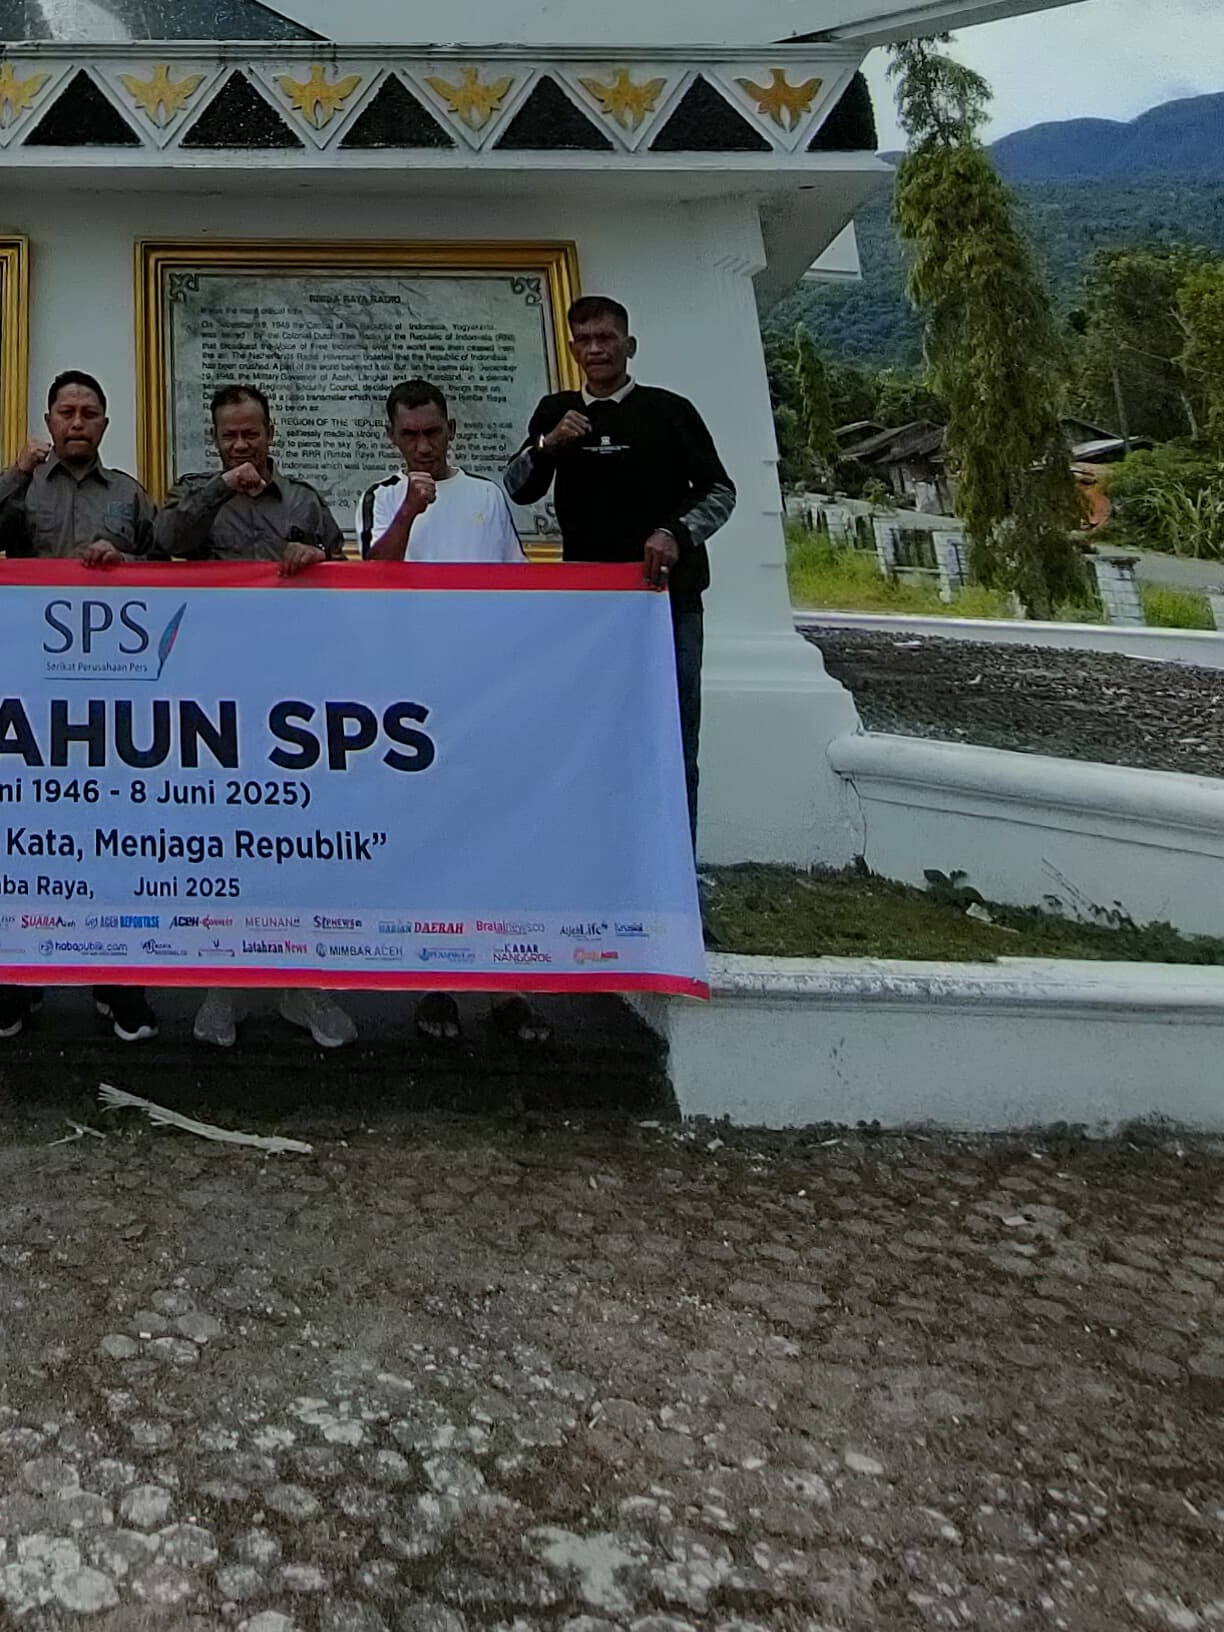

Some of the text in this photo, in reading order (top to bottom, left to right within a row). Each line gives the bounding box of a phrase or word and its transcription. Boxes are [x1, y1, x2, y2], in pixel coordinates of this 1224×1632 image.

[42, 599, 150, 655] SPS
[46, 662, 148, 673] Serikat Perusahaan Pers
[267, 699, 437, 773] SPS
[34, 779, 100, 805] 1946
[130, 780, 147, 805] 8
[156, 780, 215, 805] Juni
[226, 780, 312, 809] 2025)
[6, 828, 84, 864] Kata,
[94, 828, 224, 865] Menjaga
[234, 829, 388, 866] Republik”
[36, 876, 94, 902] Raya,
[134, 876, 179, 898] Juni
[185, 877, 240, 898] 2025
[414, 922, 465, 935] DAERAH
[329, 945, 403, 958] MIMBAR ACEH
